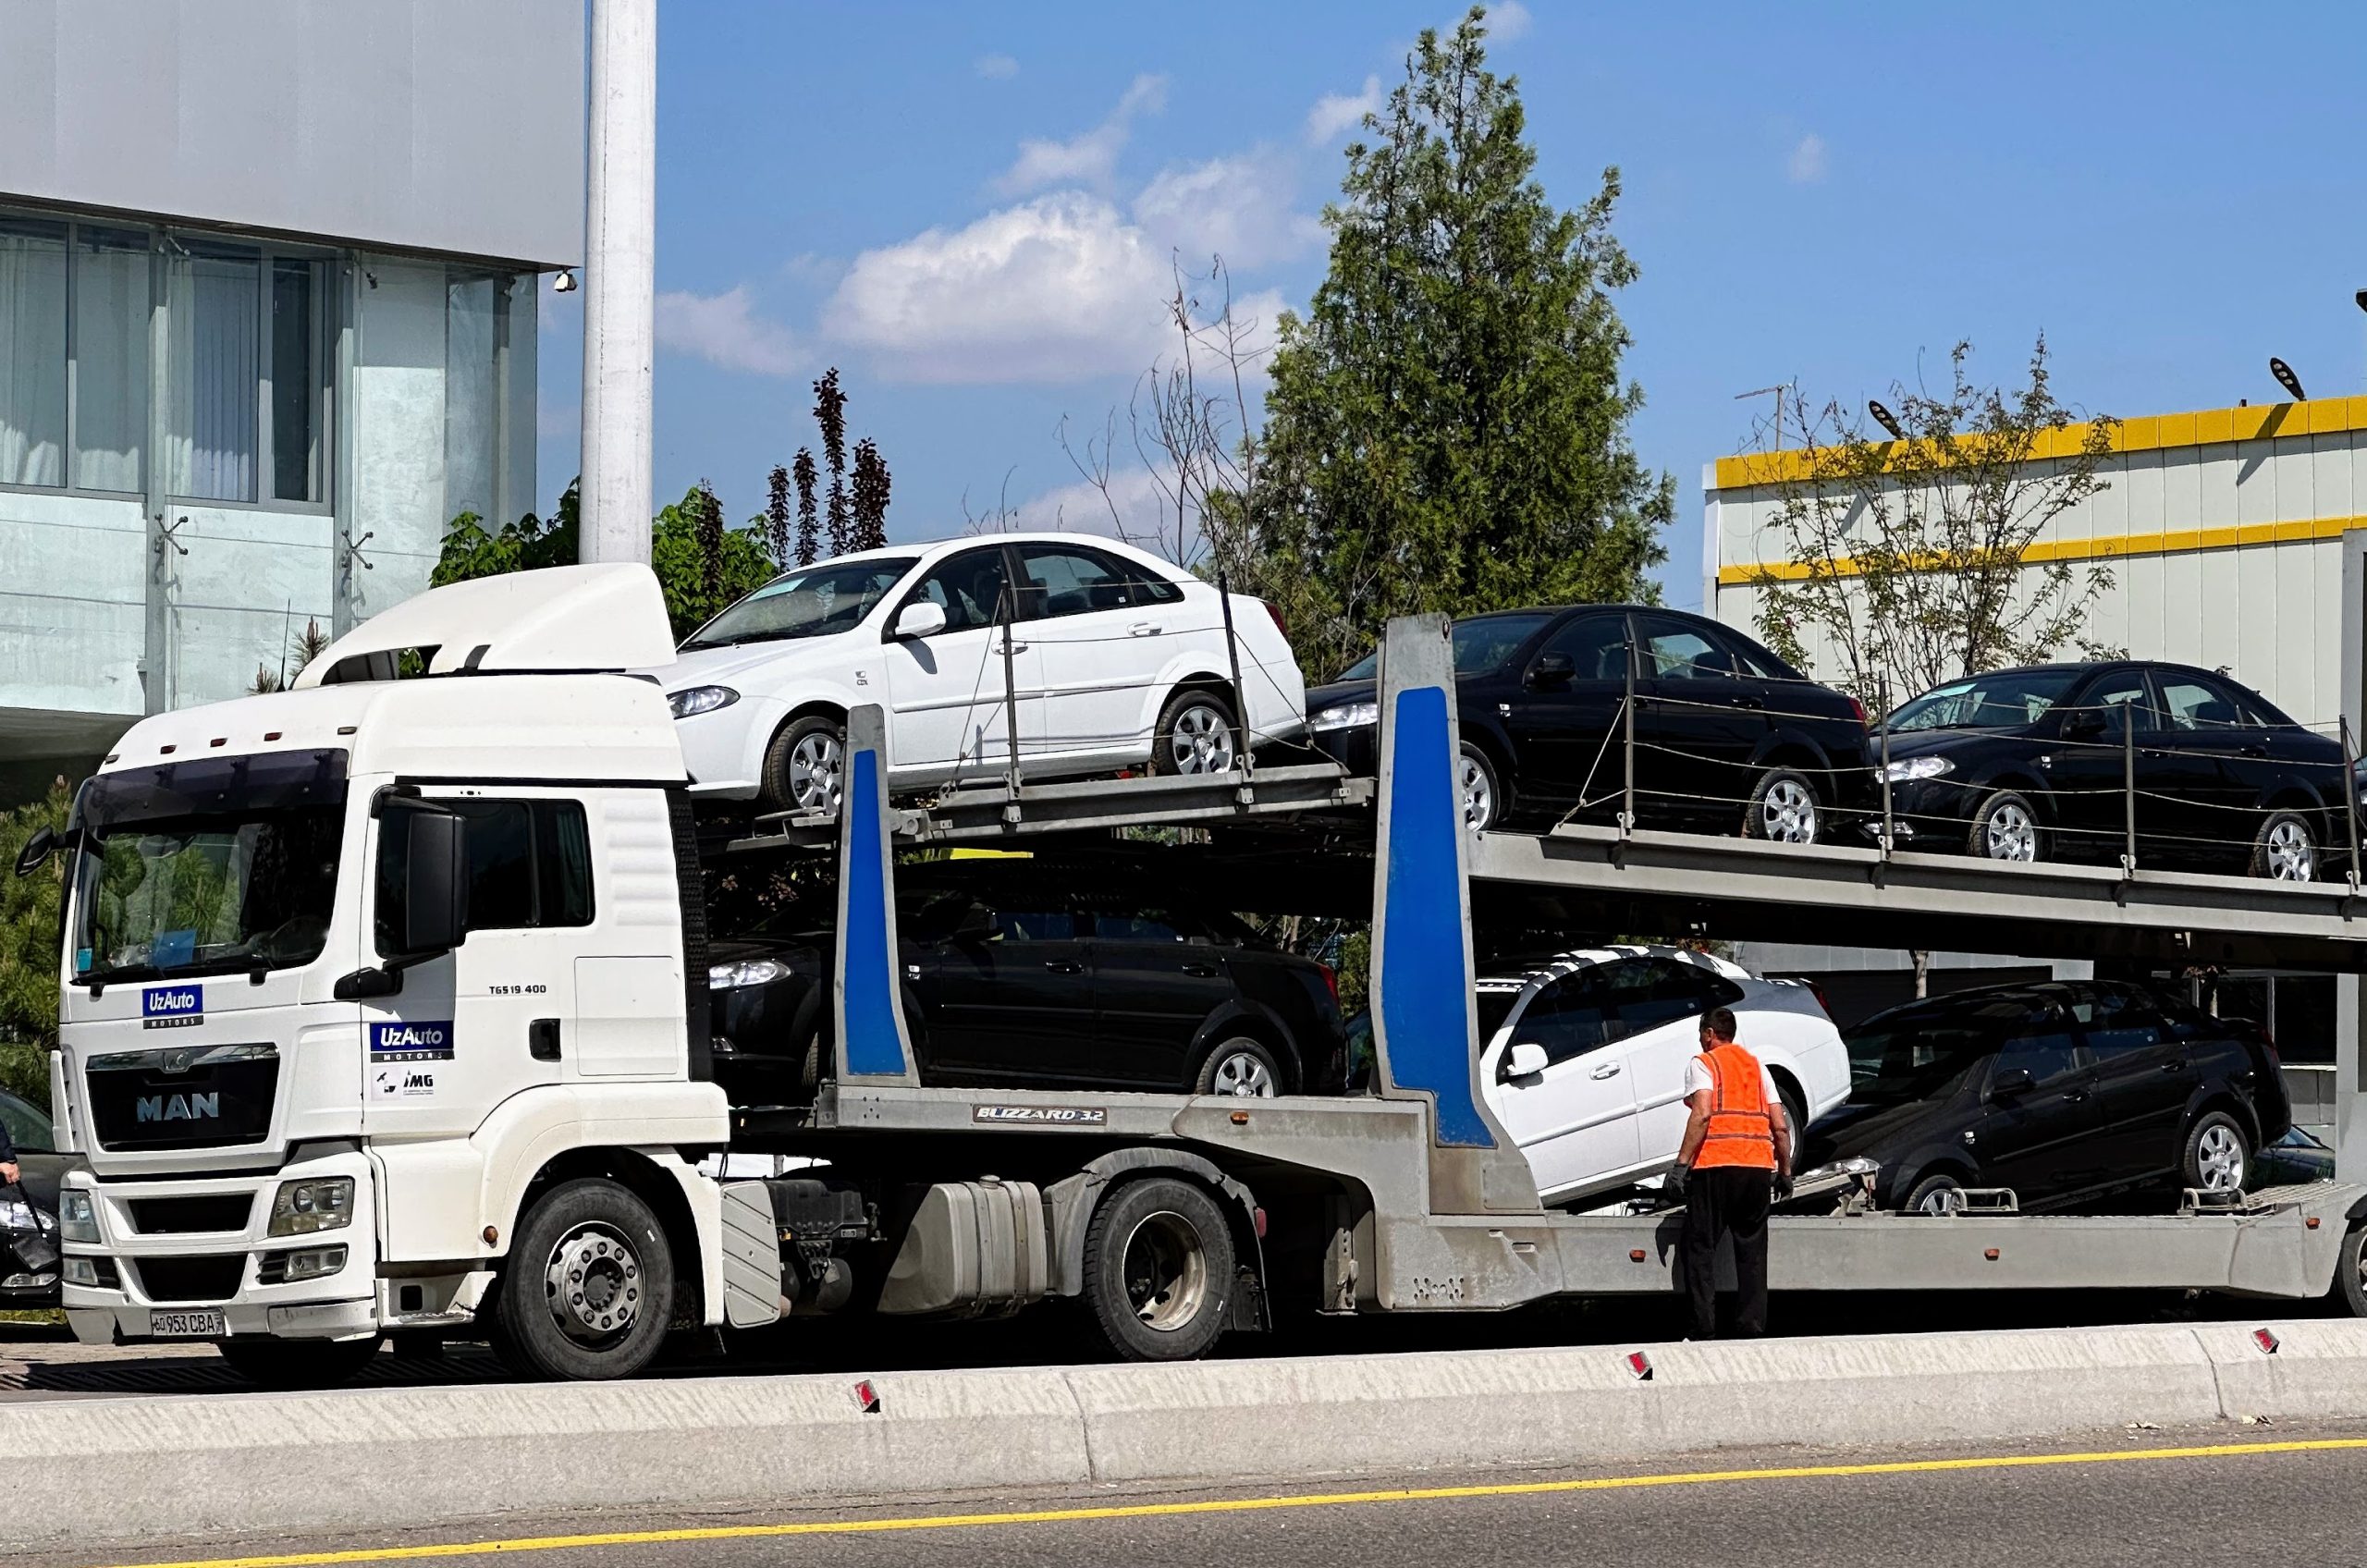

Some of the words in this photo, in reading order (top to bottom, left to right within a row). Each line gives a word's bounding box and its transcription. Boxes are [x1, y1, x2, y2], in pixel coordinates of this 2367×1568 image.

[149, 991, 195, 1011] UzAuto
[151, 1018, 195, 1028] MOTORS
[380, 1027, 443, 1047] UzAuto
[383, 1052, 442, 1061] MOTORS
[136, 1092, 219, 1122] MAN
[976, 1108, 1076, 1121] BLIZZARD
[1080, 1110, 1104, 1121] 3.2
[166, 1315, 188, 1333] 953
[190, 1314, 215, 1333] CBA
